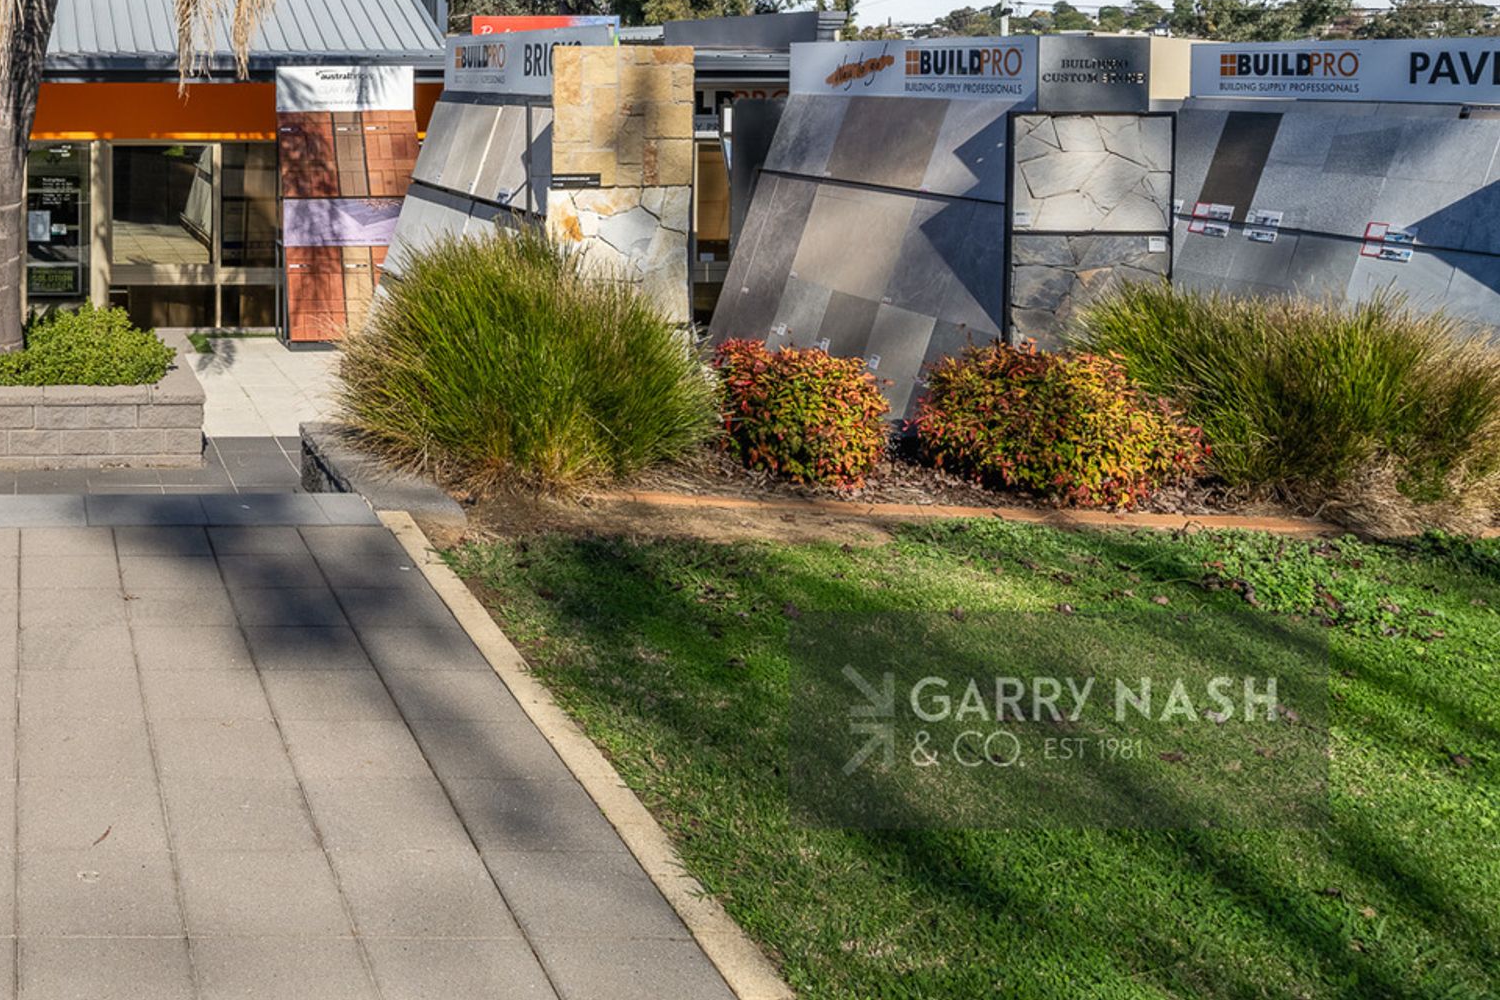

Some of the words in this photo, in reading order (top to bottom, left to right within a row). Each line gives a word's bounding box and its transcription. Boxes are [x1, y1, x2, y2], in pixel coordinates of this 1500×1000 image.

[920, 48, 1022, 76] BUILDPRO
[1238, 51, 1360, 77] BUILDPRO
[1042, 72, 1098, 84] CUSTOM
[905, 82, 935, 93] BUILDING
[937, 82, 962, 93] SUPPLY
[963, 83, 1022, 95] PROFESSIONALS
[1219, 82, 1257, 91] BUILDING
[1258, 82, 1288, 92] SUPPLY
[1289, 82, 1360, 93] PROFESSIONALS
